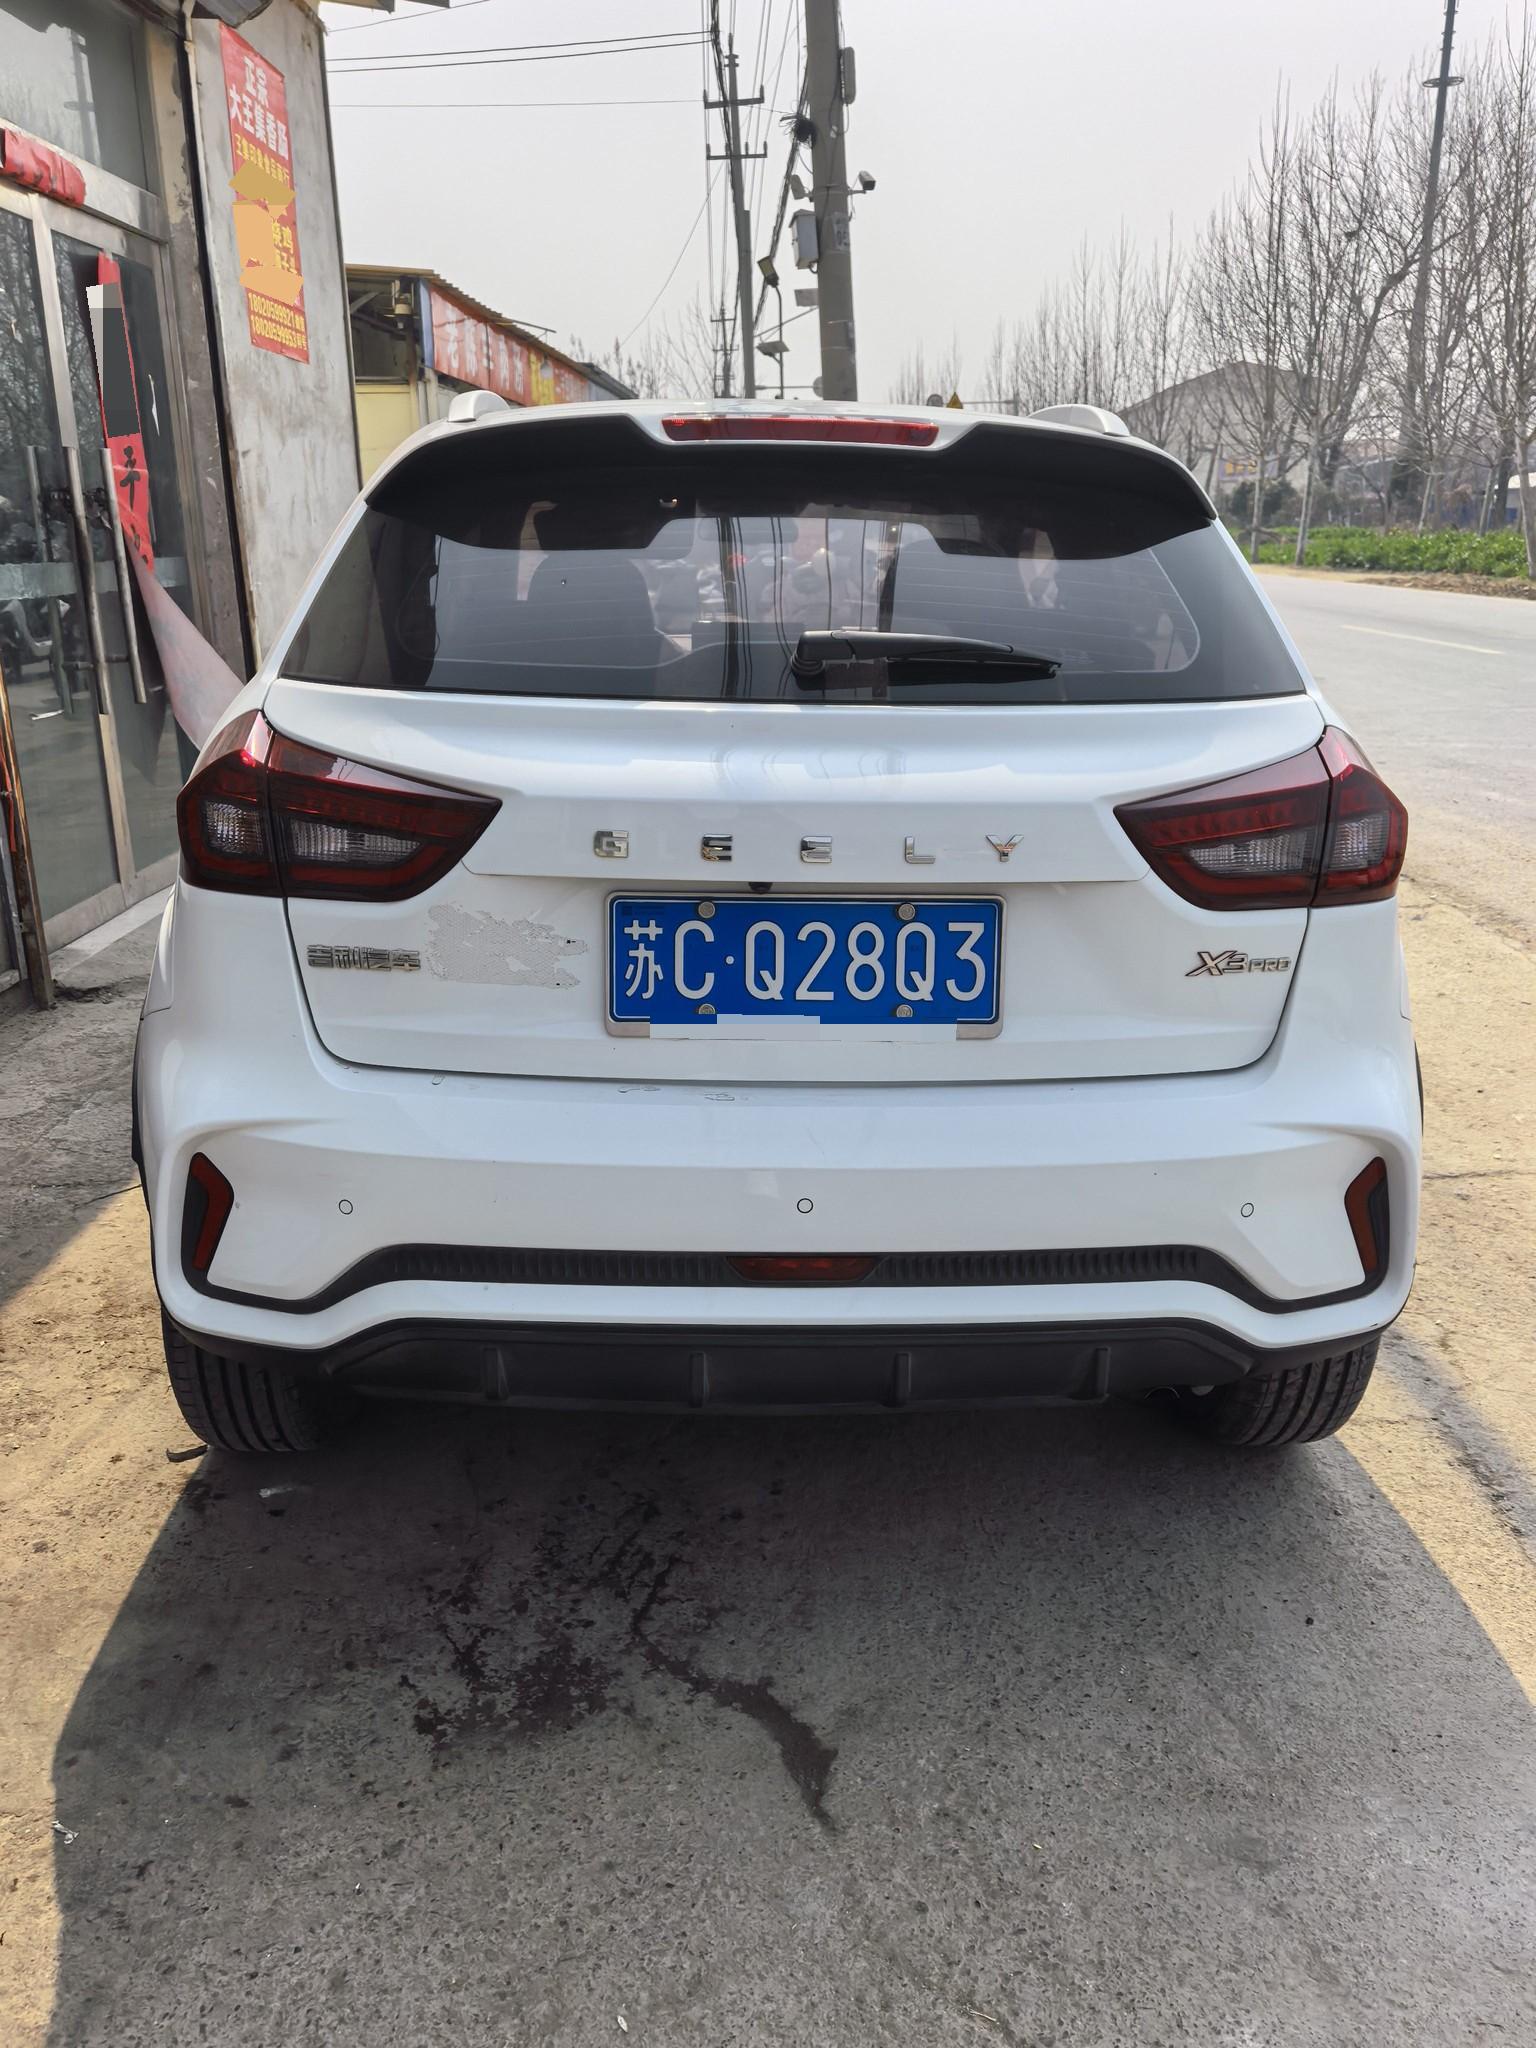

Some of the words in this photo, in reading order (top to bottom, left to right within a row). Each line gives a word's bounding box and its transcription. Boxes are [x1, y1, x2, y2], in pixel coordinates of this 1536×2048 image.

[593, 829, 1025, 866] GEELY
[307, 944, 421, 972] 吉利汽车
